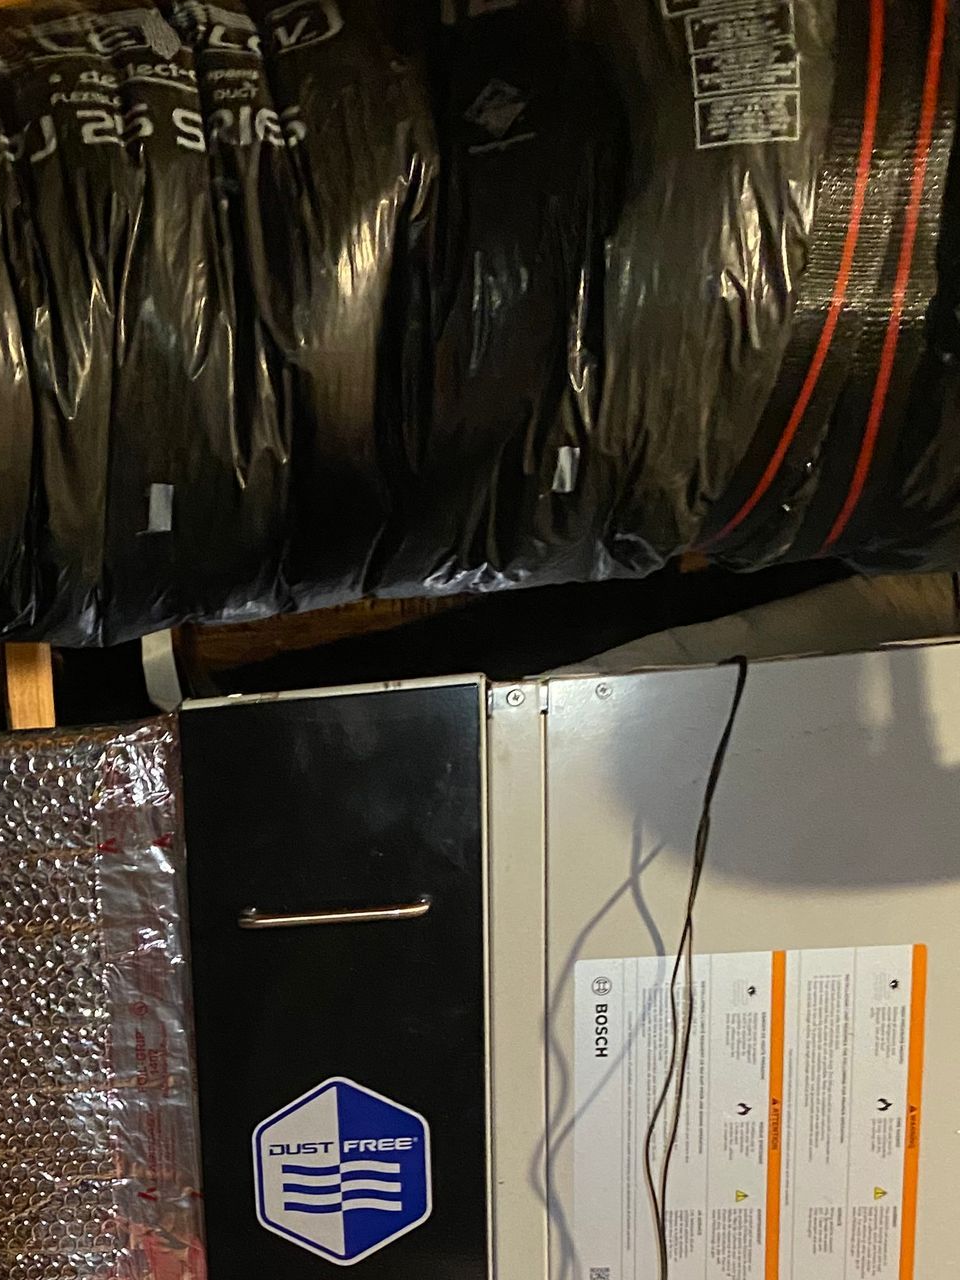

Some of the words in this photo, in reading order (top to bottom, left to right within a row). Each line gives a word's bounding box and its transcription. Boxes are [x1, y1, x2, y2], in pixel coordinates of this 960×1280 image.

[594, 1003, 609, 1059] BOSCH
[269, 1141, 334, 1156] DUST
[343, 1137, 413, 1153] FREE
